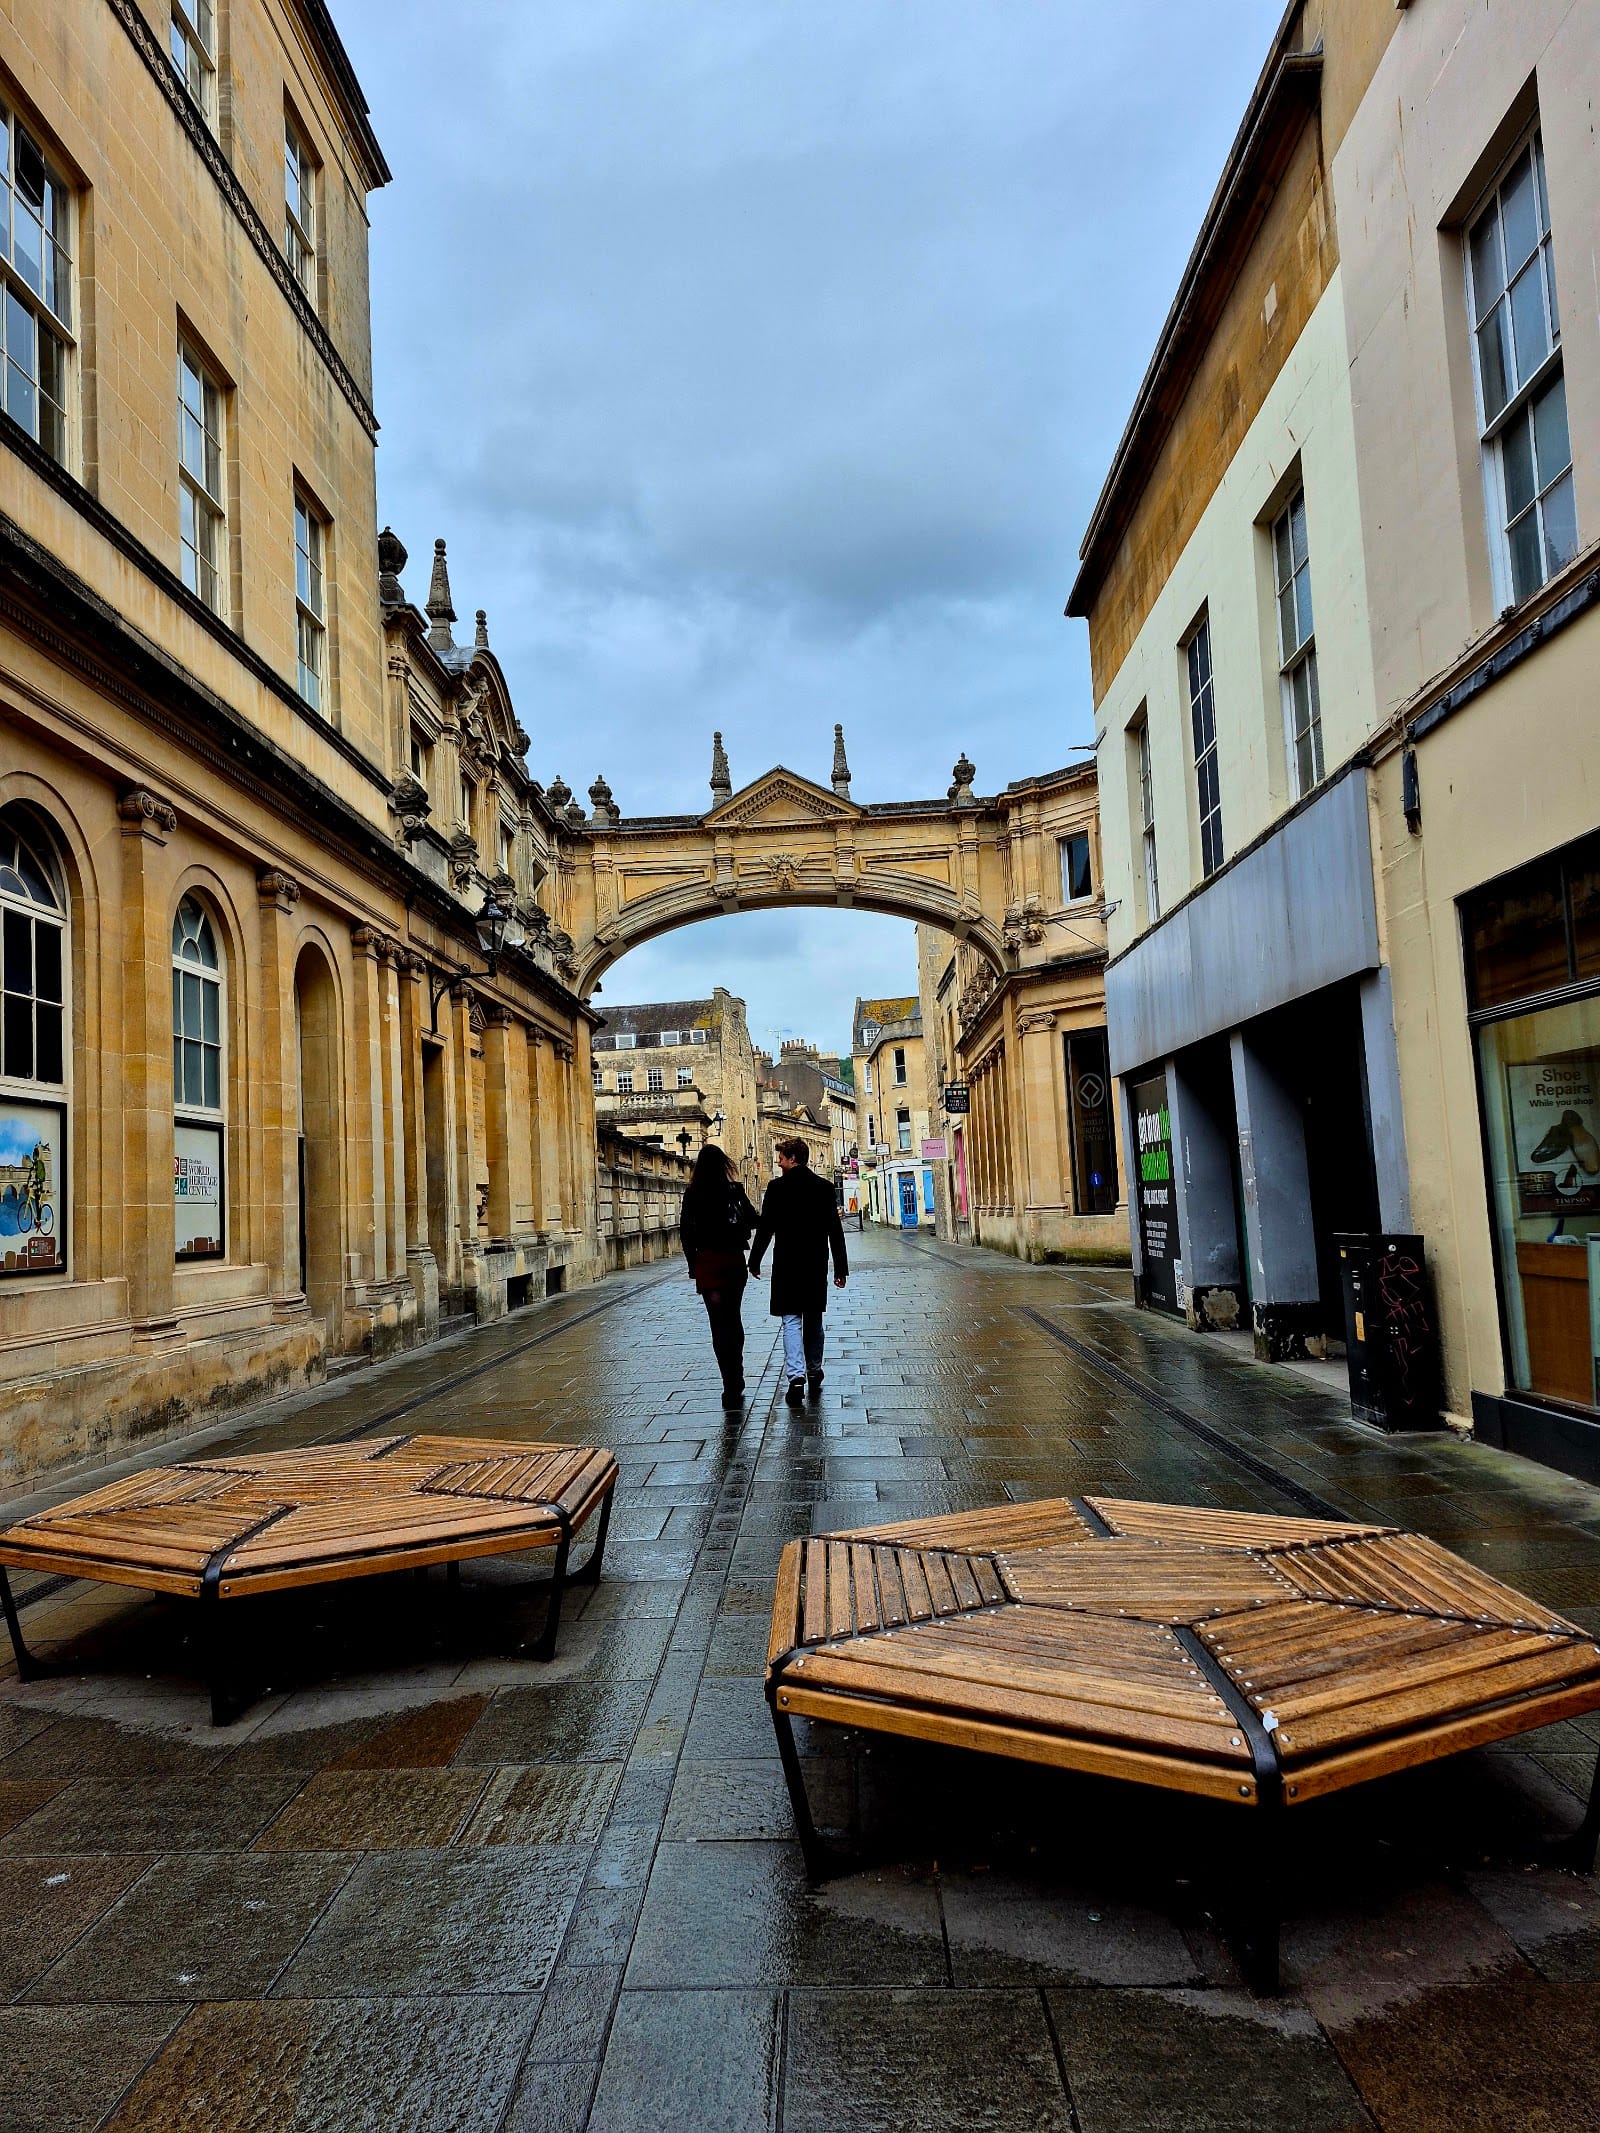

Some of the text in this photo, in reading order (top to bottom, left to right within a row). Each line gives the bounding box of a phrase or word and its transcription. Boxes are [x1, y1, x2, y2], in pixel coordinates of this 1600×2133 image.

[1542, 1068, 1582, 1083] Shoe
[1535, 1082, 1591, 1098] Repairs
[1529, 1098, 1594, 1108] While you shop
[189, 1165, 210, 1175] WORLD
[189, 1175, 218, 1186] HERITAGE
